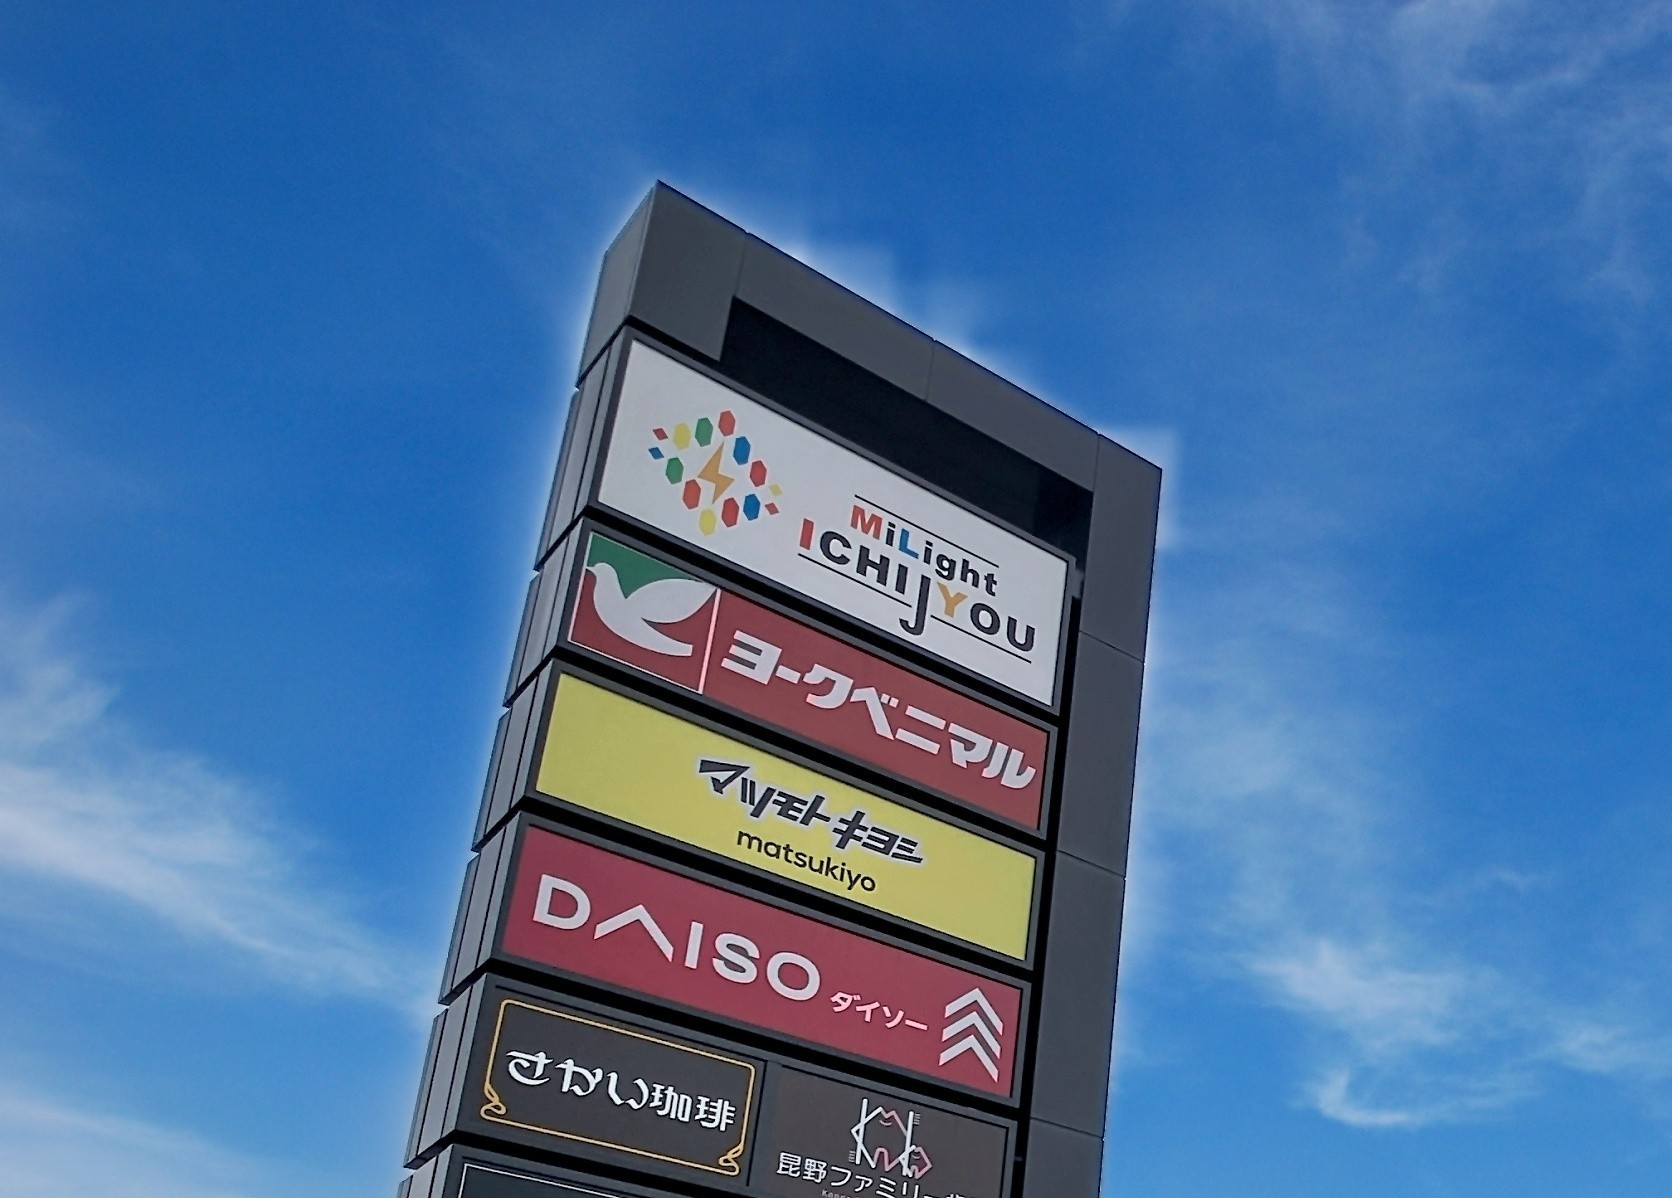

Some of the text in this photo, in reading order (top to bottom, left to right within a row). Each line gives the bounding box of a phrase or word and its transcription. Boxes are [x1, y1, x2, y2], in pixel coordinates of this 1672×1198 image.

[799, 518, 1036, 653] ICHIJYOU
[850, 503, 998, 597] MiLight
[721, 629, 1037, 790] ヨークベニマル
[737, 828, 877, 893] matsukiyo
[532, 873, 821, 1001] DAISO
[830, 991, 929, 1033] ダイソー
[506, 1049, 737, 1133] さかい珈琲
